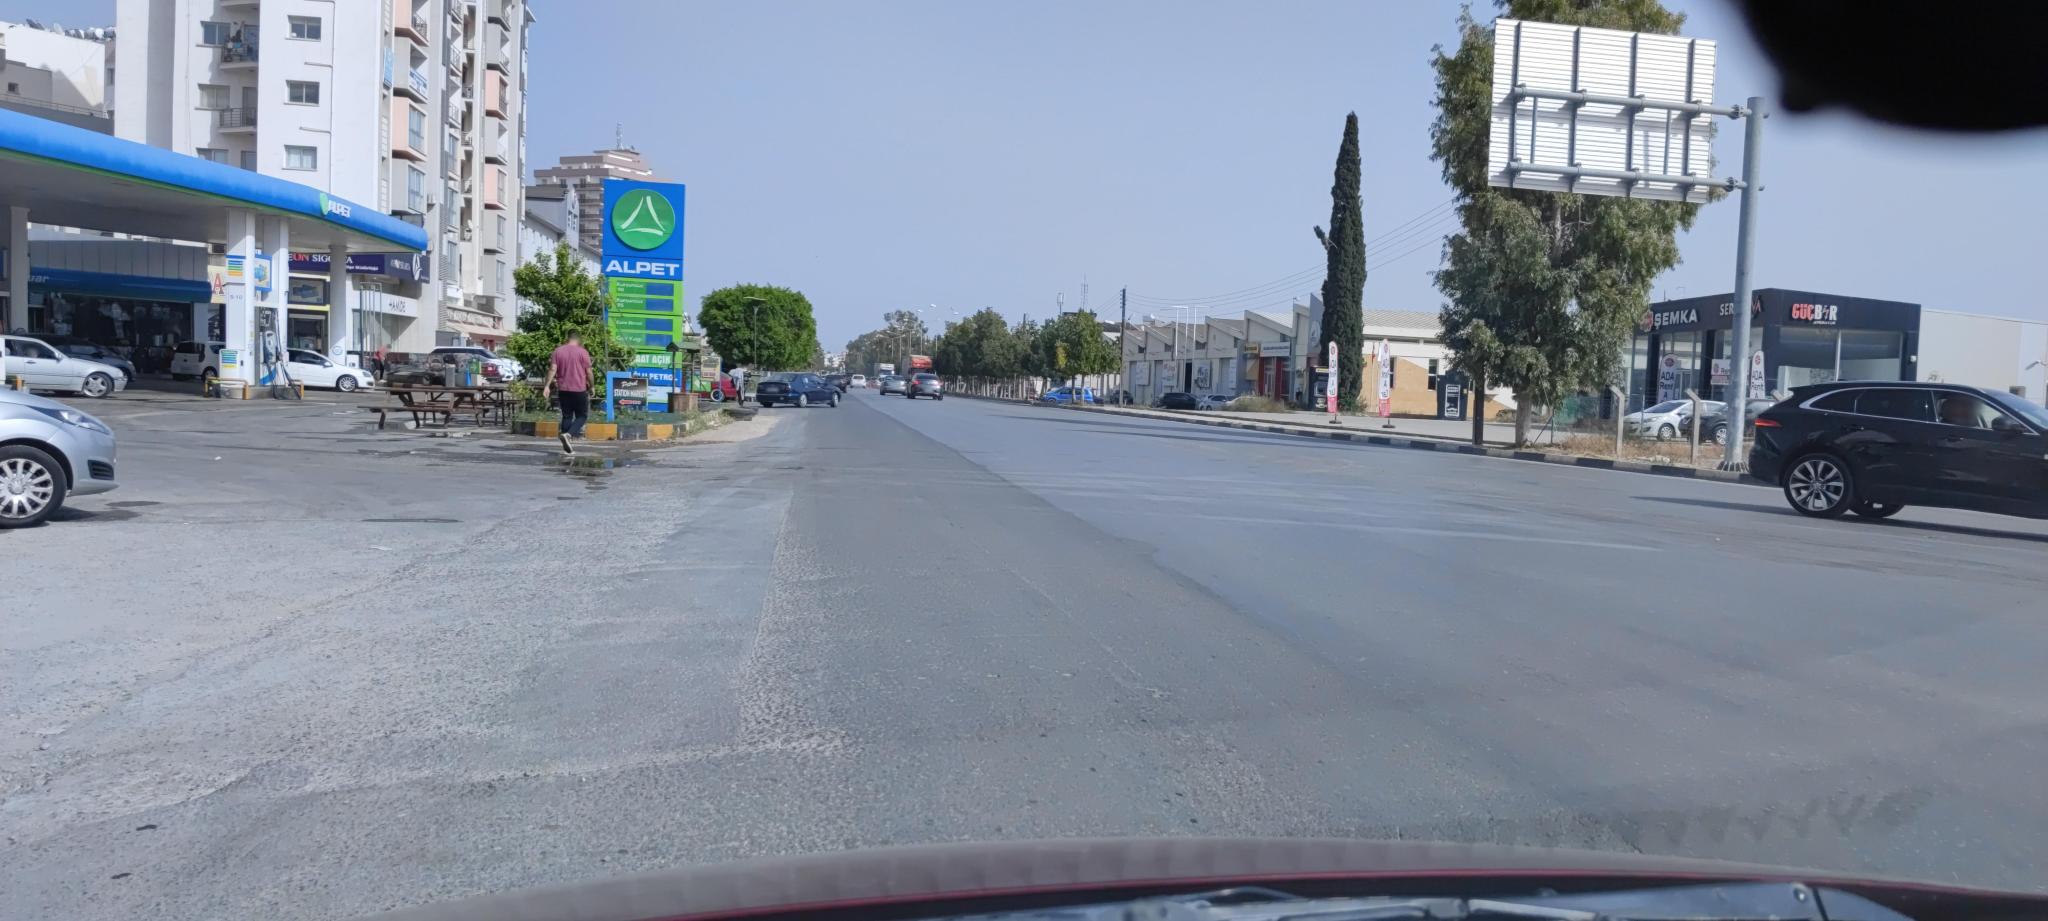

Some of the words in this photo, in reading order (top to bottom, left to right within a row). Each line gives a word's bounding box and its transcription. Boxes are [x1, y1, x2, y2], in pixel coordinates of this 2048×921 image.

[605, 259, 680, 276] ALPET
[1654, 309, 1698, 329] ŞEMKA
[1661, 371, 1674, 380] ADA
[1752, 370, 1763, 381] ADA
[1660, 381, 1673, 390] Rent
[1752, 382, 1764, 391] Rent
